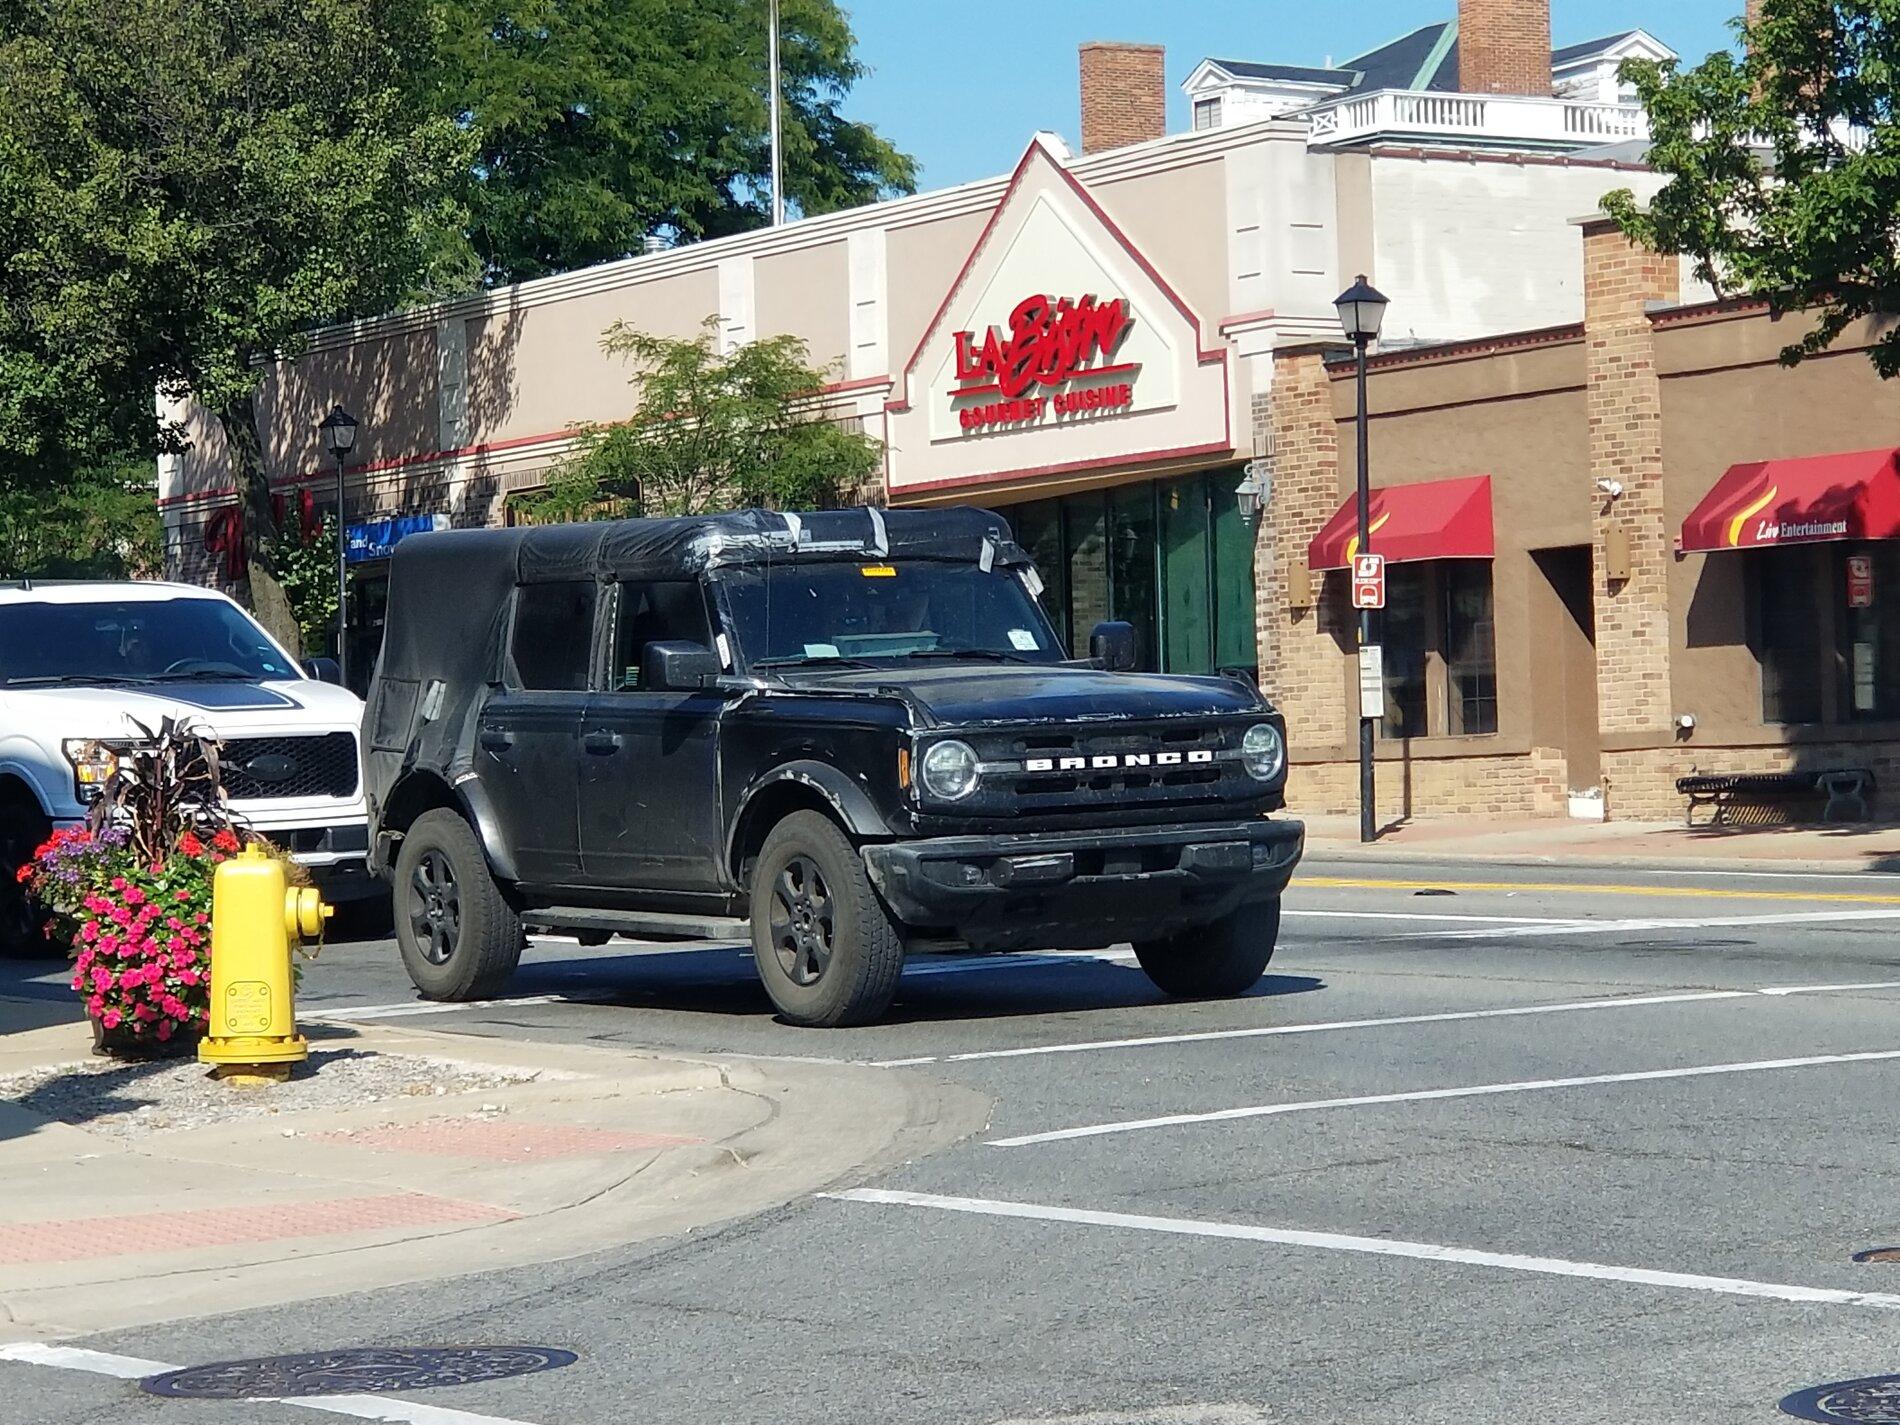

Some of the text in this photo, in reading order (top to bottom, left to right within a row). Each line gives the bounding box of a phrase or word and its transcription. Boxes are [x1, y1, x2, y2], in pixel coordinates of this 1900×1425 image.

[960, 384, 1132, 428] GOURMET CUISINE
[1780, 520, 1848, 538] Entertainment
[350, 534, 368, 549] and
[1026, 750, 1213, 772] BRONCO
